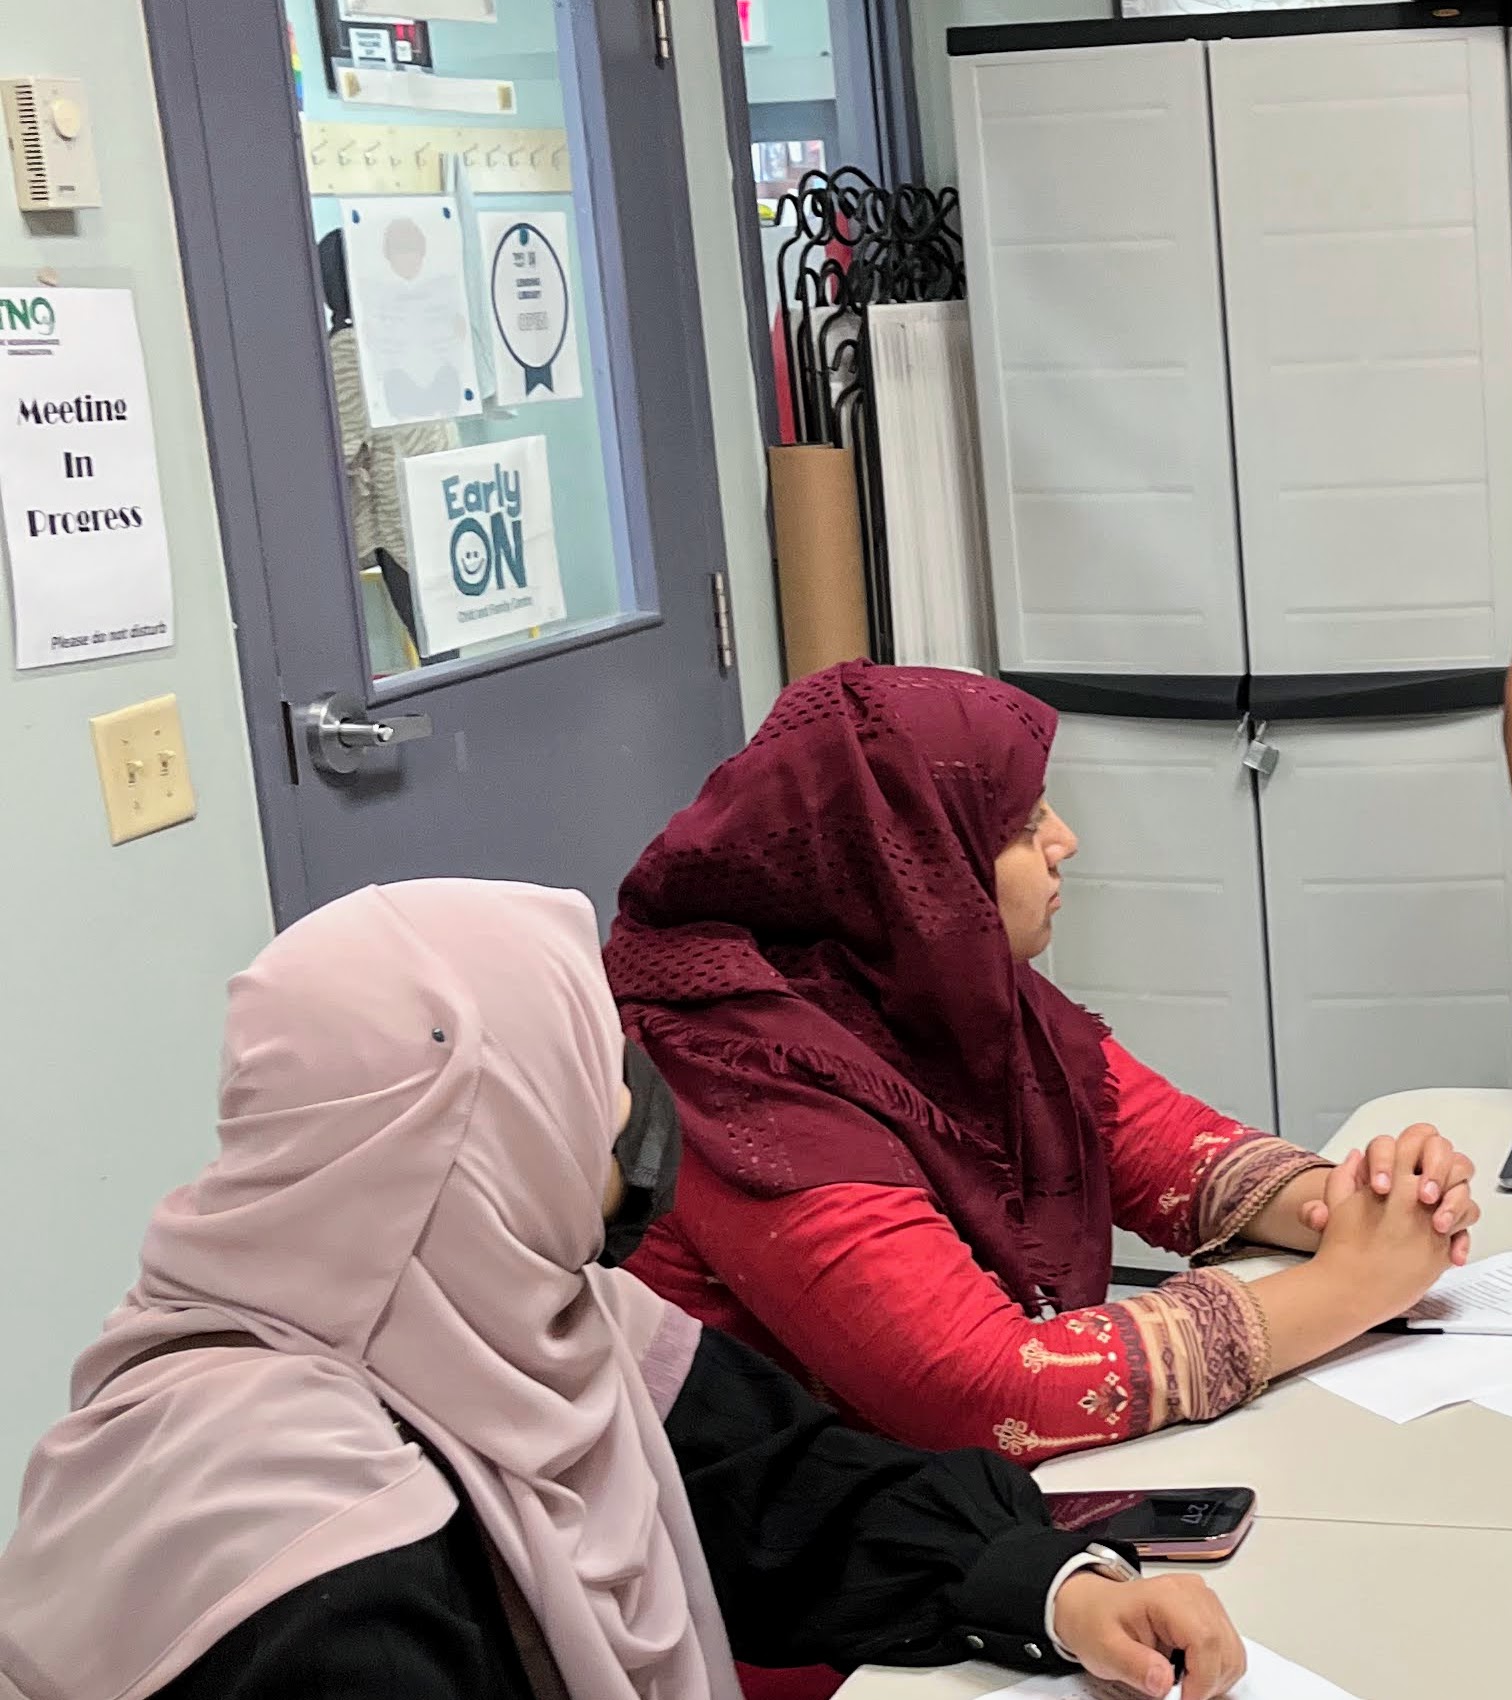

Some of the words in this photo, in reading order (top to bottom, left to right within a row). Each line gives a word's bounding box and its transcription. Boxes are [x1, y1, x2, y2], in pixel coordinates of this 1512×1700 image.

[16, 394, 127, 425] Meeting
[63, 451, 94, 478] In
[441, 463, 521, 520] Early
[27, 505, 143, 537] Progress
[450, 513, 527, 596] ON
[51, 634, 89, 650] Please
[93, 630, 106, 644] do
[110, 628, 128, 641] not
[130, 620, 167, 638] disturb
